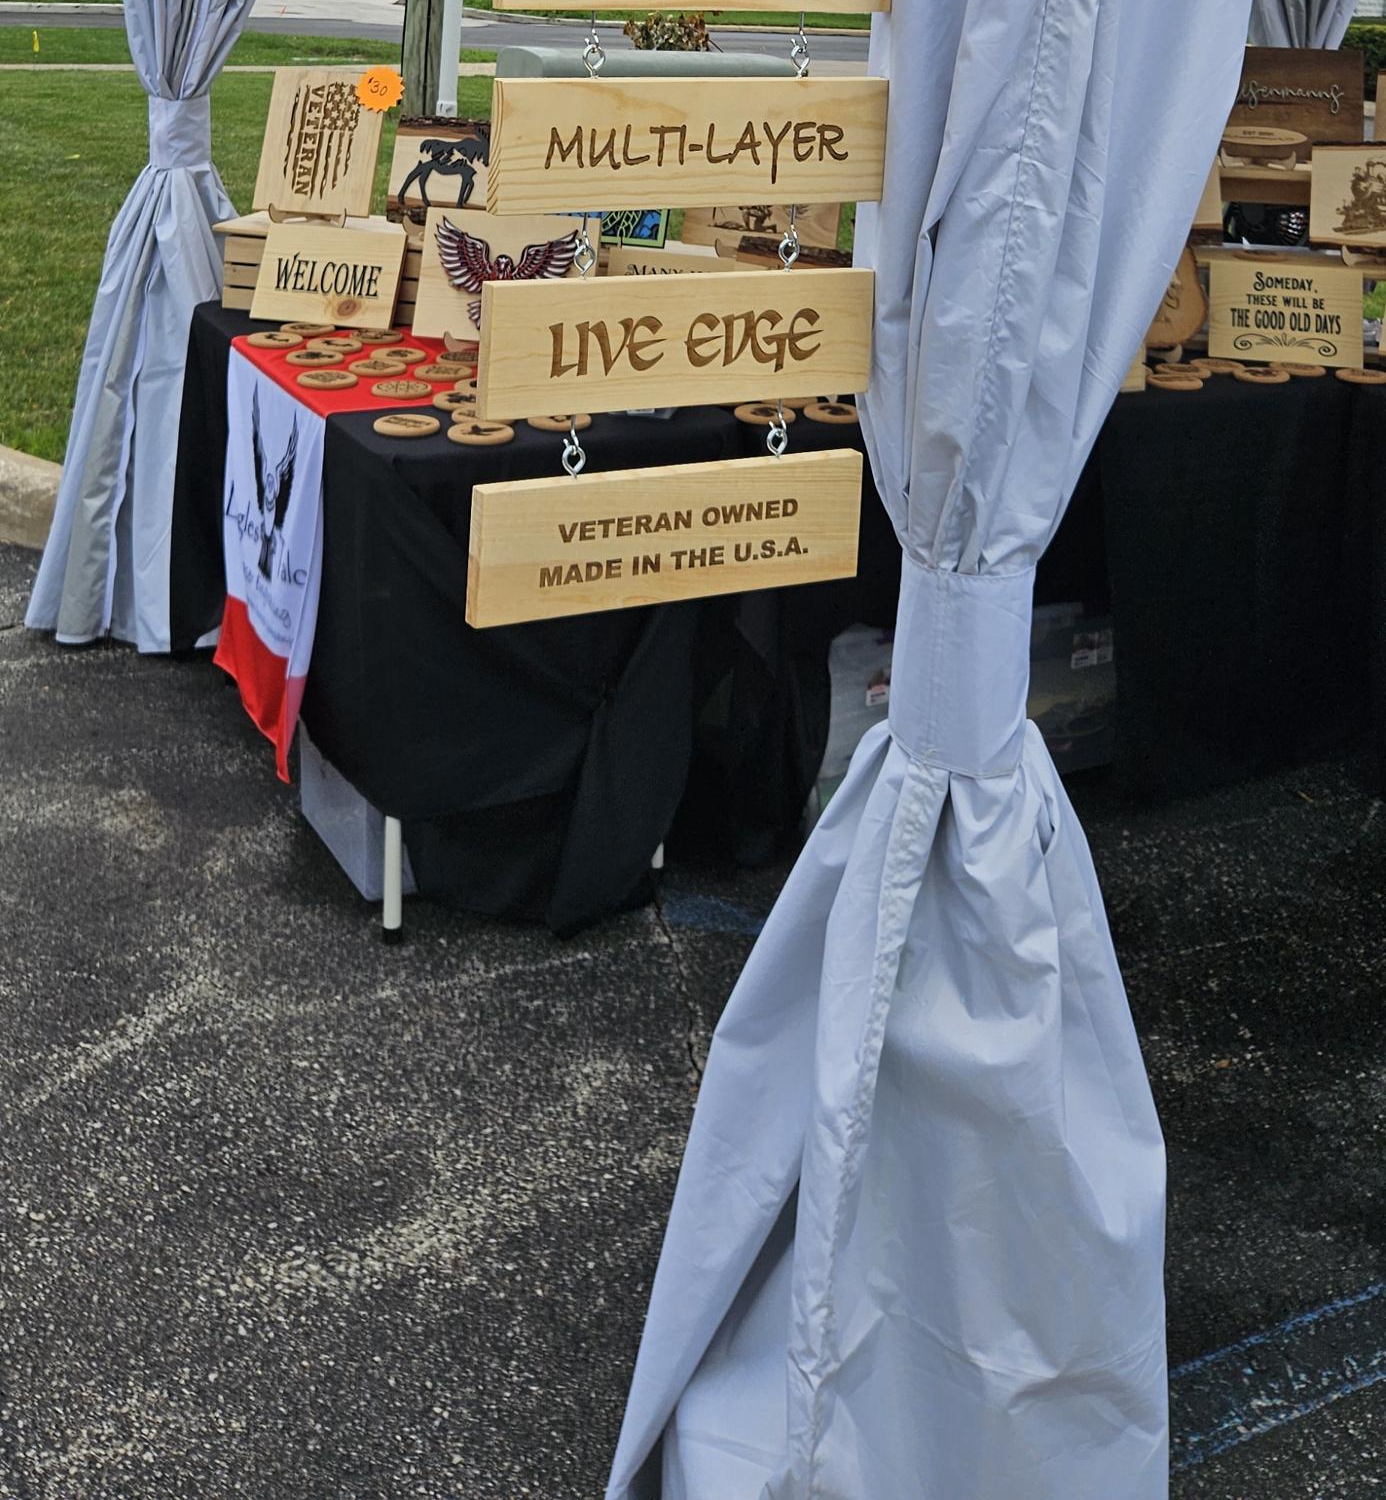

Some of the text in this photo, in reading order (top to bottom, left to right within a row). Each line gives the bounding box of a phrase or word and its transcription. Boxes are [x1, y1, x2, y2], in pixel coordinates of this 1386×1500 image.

[294, 85, 326, 196] VETERAN
[544, 121, 849, 184] MULTI-LAYER
[275, 252, 383, 299] WELCOME
[1230, 308, 1341, 335] THE GOOD OLD DAYS
[1246, 293, 1325, 310] THESE WILL BE
[548, 307, 825, 379] LIVE EDGE
[558, 498, 800, 544] VETERAN OWNED
[539, 536, 810, 589] MADE IN THE U.S.A.
